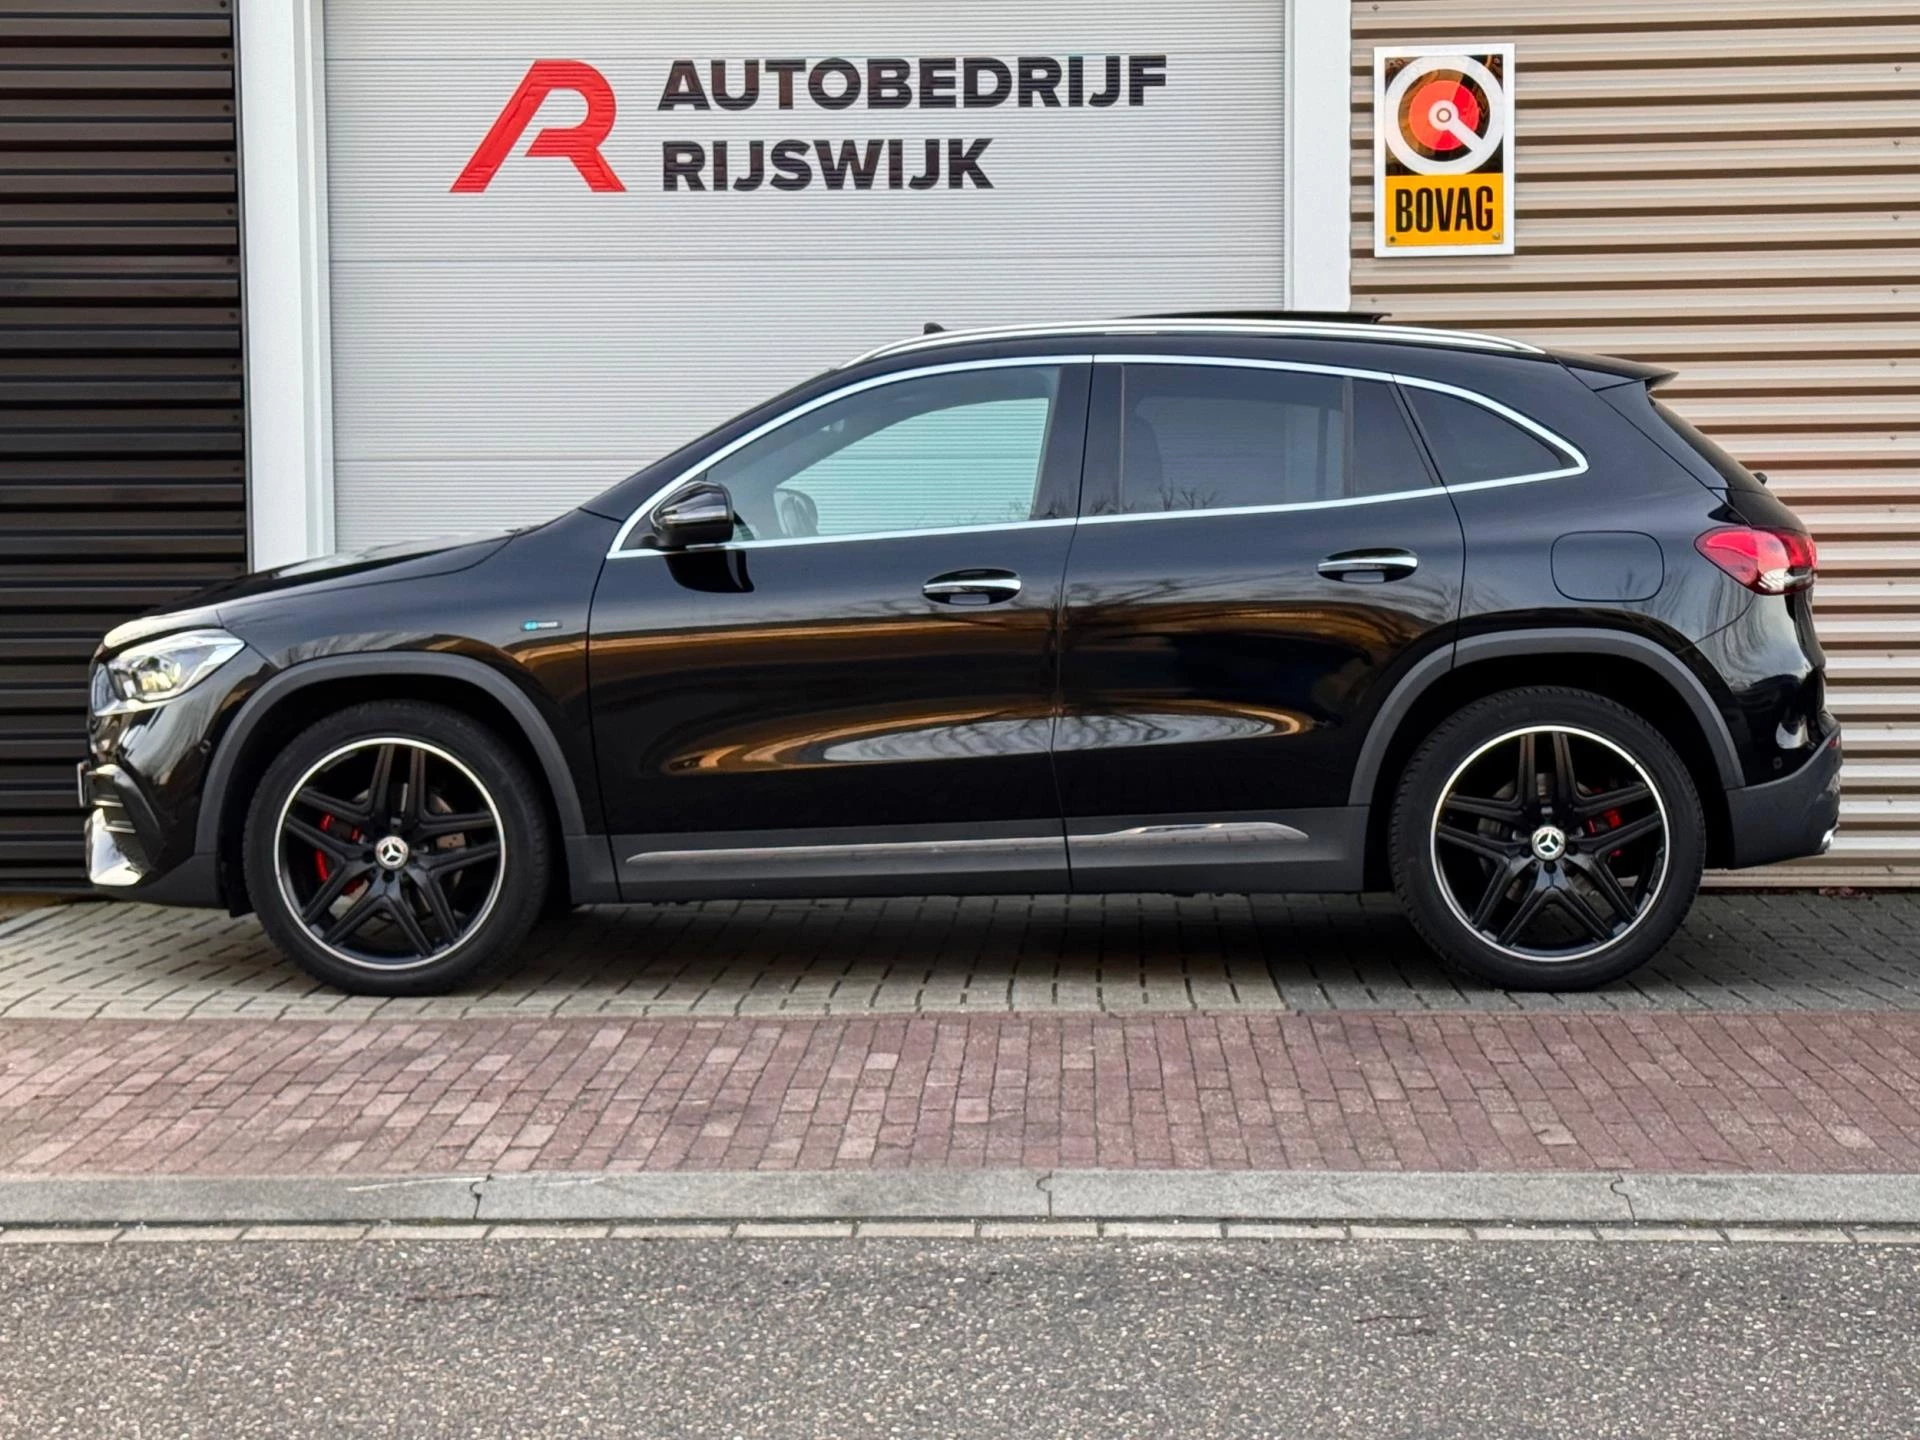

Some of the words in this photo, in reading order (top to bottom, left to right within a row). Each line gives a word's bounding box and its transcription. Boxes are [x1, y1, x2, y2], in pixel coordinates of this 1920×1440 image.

[658, 55, 1167, 111] AUTOBEDRIJF
[662, 138, 994, 192] RIJSWIJK
[1395, 186, 1493, 233] BOVAG
